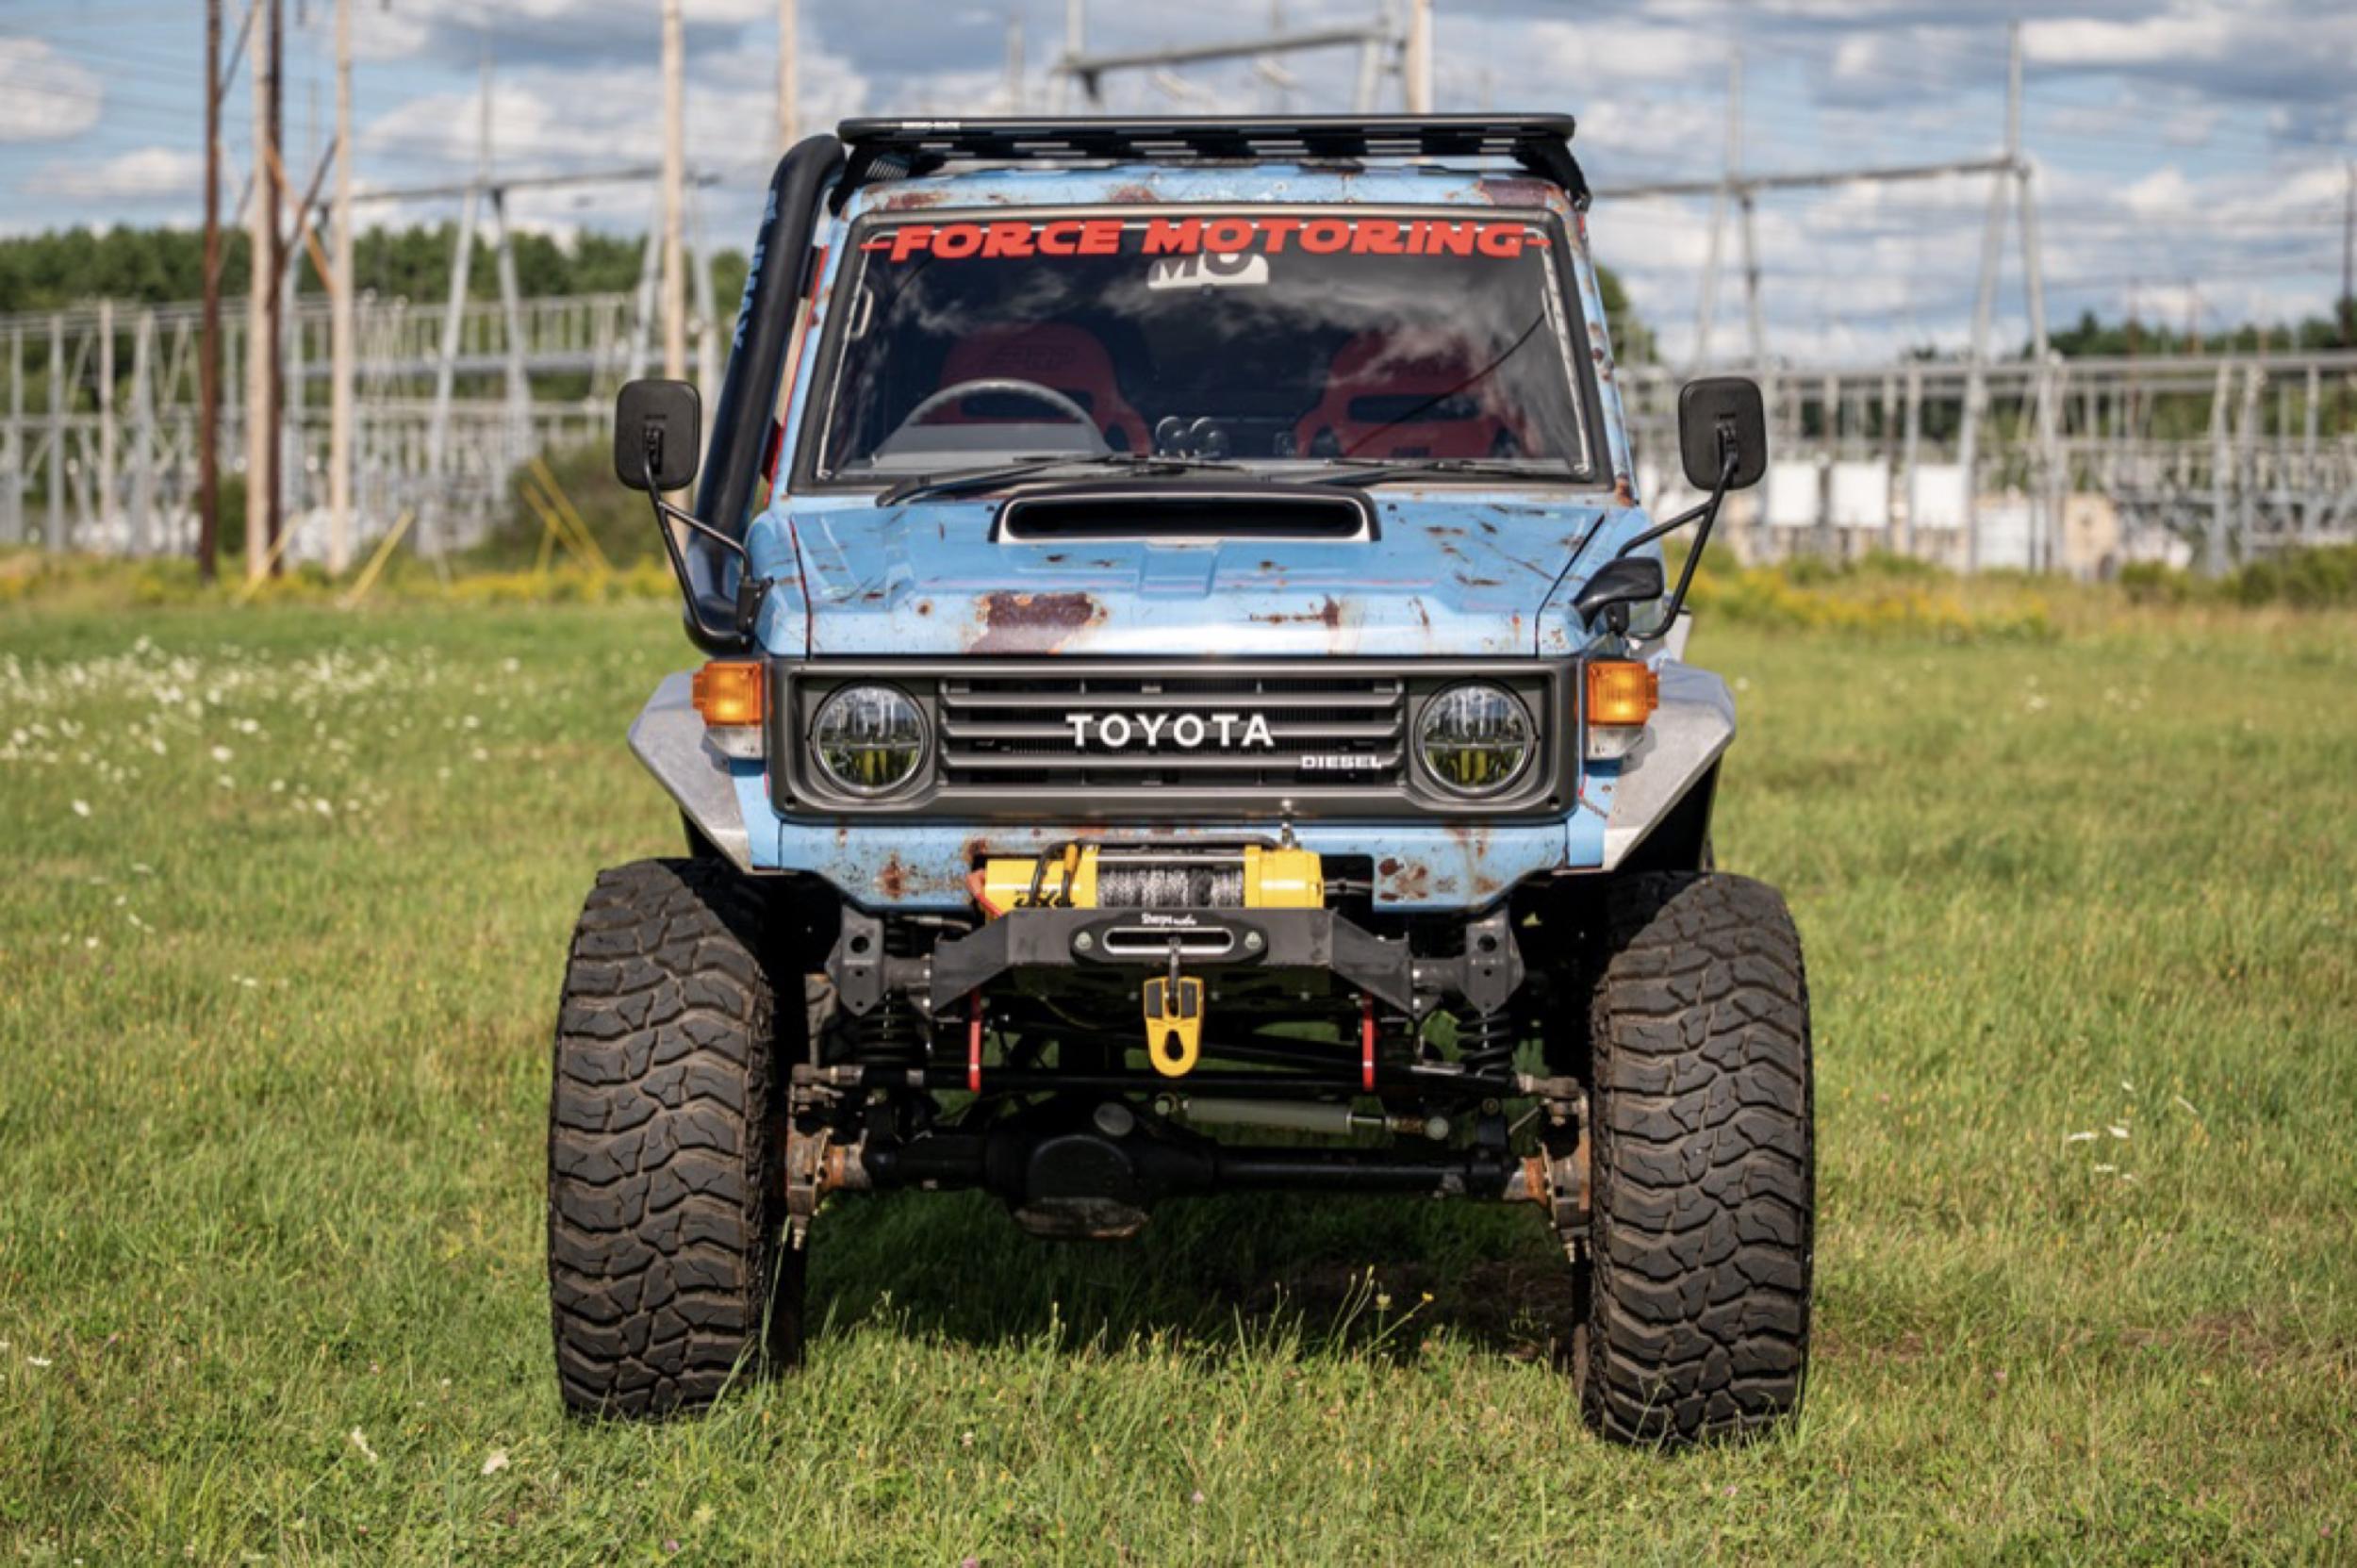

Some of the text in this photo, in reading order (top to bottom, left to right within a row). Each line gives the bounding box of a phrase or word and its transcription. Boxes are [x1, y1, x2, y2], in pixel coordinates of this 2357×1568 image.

[890, 217, 1524, 262] FORCE MOTORING
[1065, 714, 1275, 749] TOYOTA
[1301, 754, 1382, 769] DIESEL
